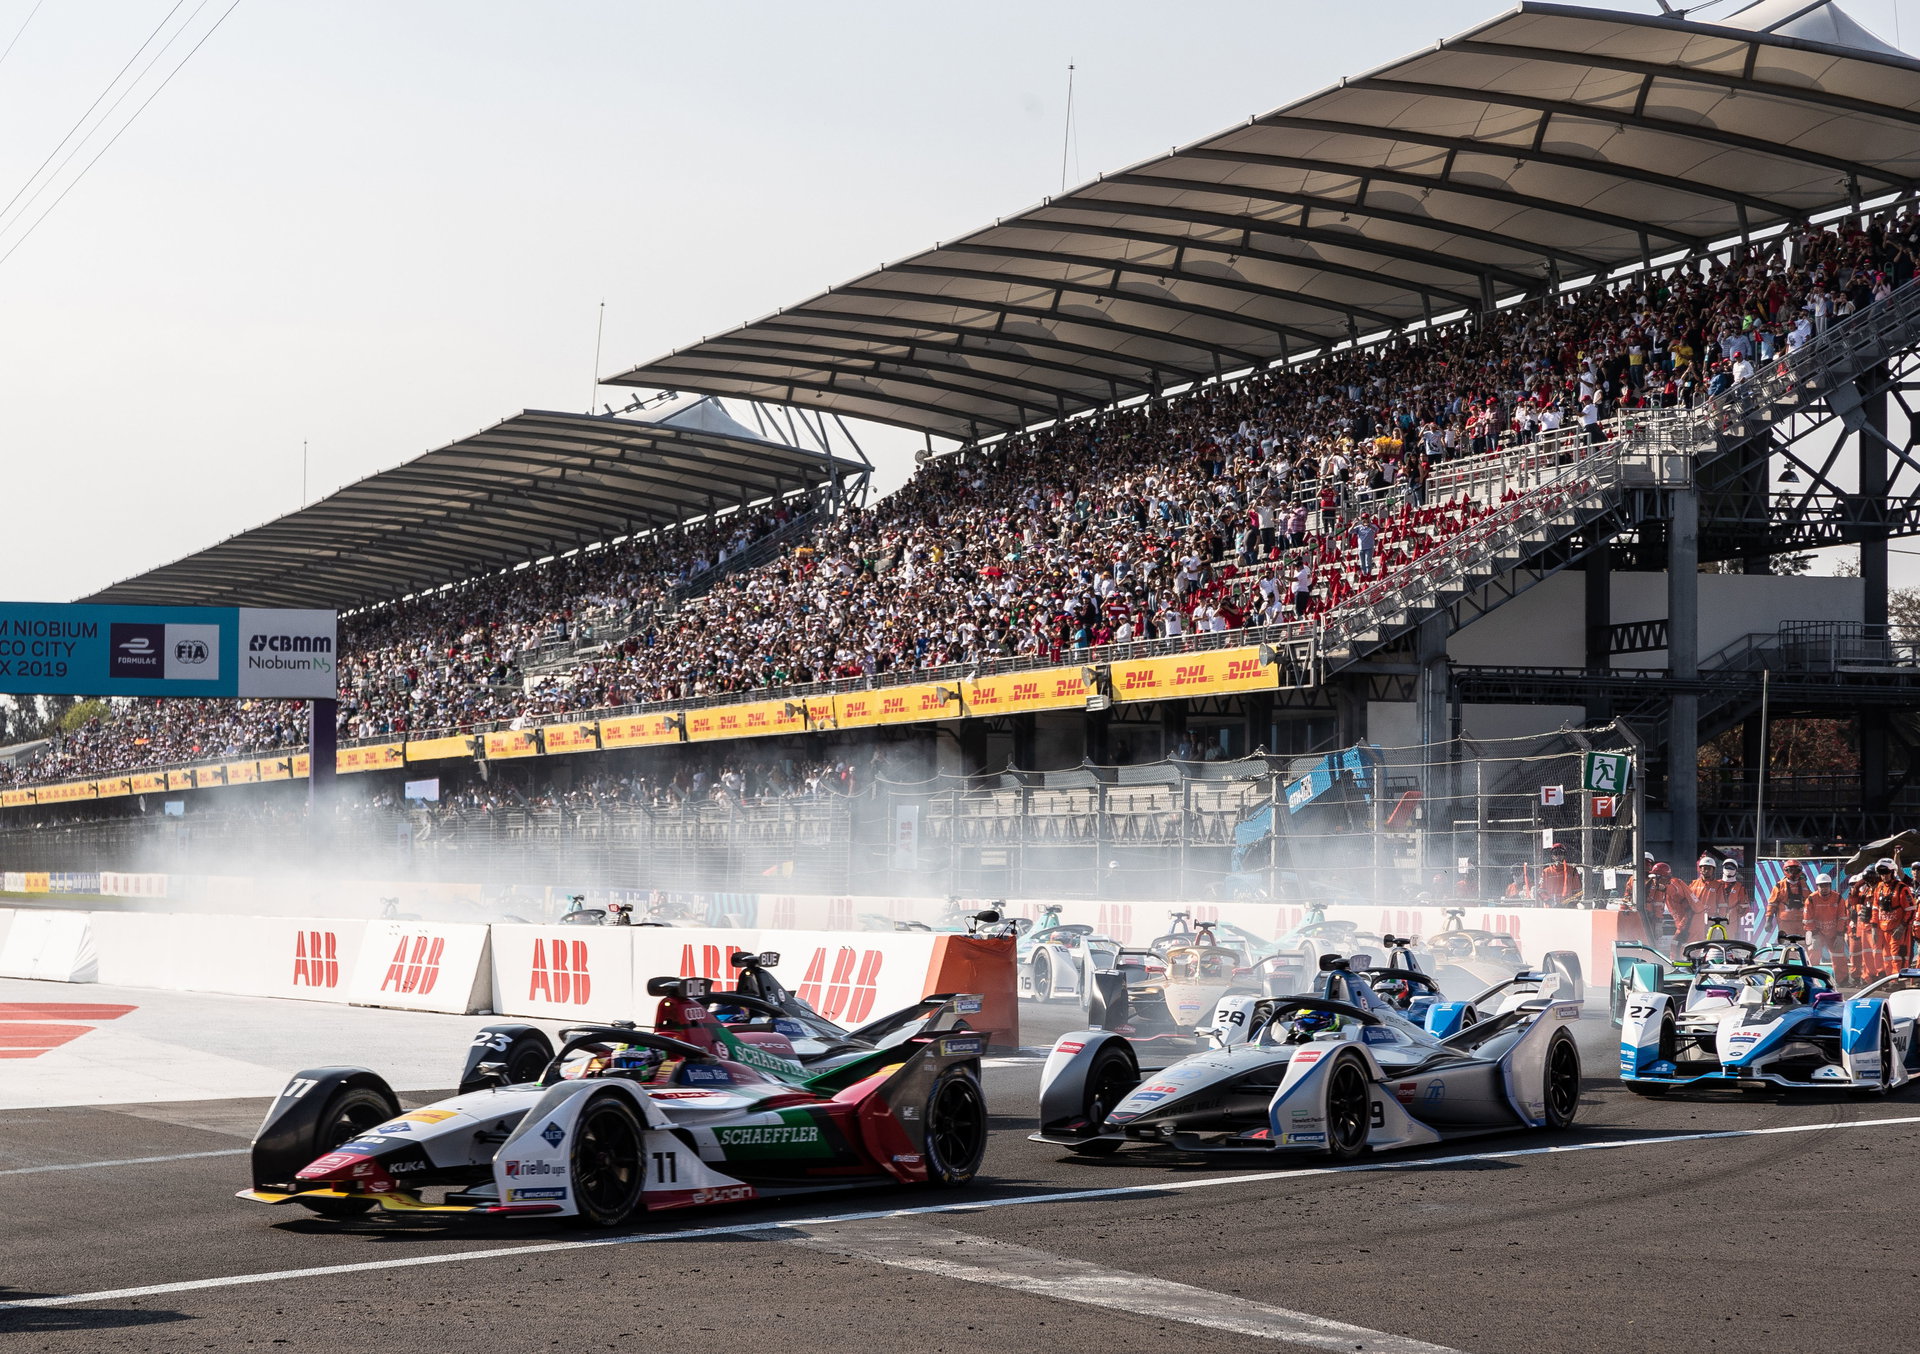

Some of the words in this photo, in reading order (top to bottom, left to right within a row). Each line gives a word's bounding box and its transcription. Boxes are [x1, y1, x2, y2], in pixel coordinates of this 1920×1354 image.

[13, 621, 98, 638] NIOBIUM
[0, 640, 26, 656] CO
[31, 641, 76, 657] CITY
[177, 645, 206, 659] FIA
[268, 635, 332, 653] CBMM
[17, 660, 67, 677] 2019
[248, 655, 311, 670] Niobium
[1125, 670, 1156, 689] DHL
[1176, 665, 1208, 684] DHL
[1228, 659, 1262, 680] DHL
[972, 688, 996, 705] DHL
[1013, 683, 1040, 701] DHL
[1056, 678, 1085, 697] DHL
[846, 702, 866, 718] DHL
[883, 698, 904, 714] DHL
[693, 719, 709, 732] DHL
[720, 715, 736, 729] DHL
[748, 711, 765, 726] DHL
[1544, 788, 1556, 803] F
[1596, 800, 1609, 815] F
[1098, 903, 1133, 945] ABB
[293, 930, 338, 988] ABB
[380, 935, 445, 995] ABB
[761, 953, 778, 966] BUE
[529, 938, 591, 1005] ABB
[686, 979, 705, 996] DIG
[800, 947, 883, 1023] ABB
[1020, 976, 1032, 990] 16
[1218, 1010, 1246, 1027] 28
[1630, 1005, 1658, 1019] 27
[469, 1031, 513, 1052] 23
[687, 1069, 714, 1082] Julius
[715, 1069, 729, 1080] Bär
[283, 1078, 319, 1098] 11
[1371, 1101, 1385, 1128] 9
[720, 1126, 818, 1145] SCHAEFFLER
[389, 1160, 427, 1173] KUKA
[521, 1160, 550, 1175] riello
[552, 1166, 566, 1177] ups
[652, 1151, 677, 1183] 11
[523, 1190, 564, 1198] MICHELIN
[692, 1186, 752, 1204] e-tron
